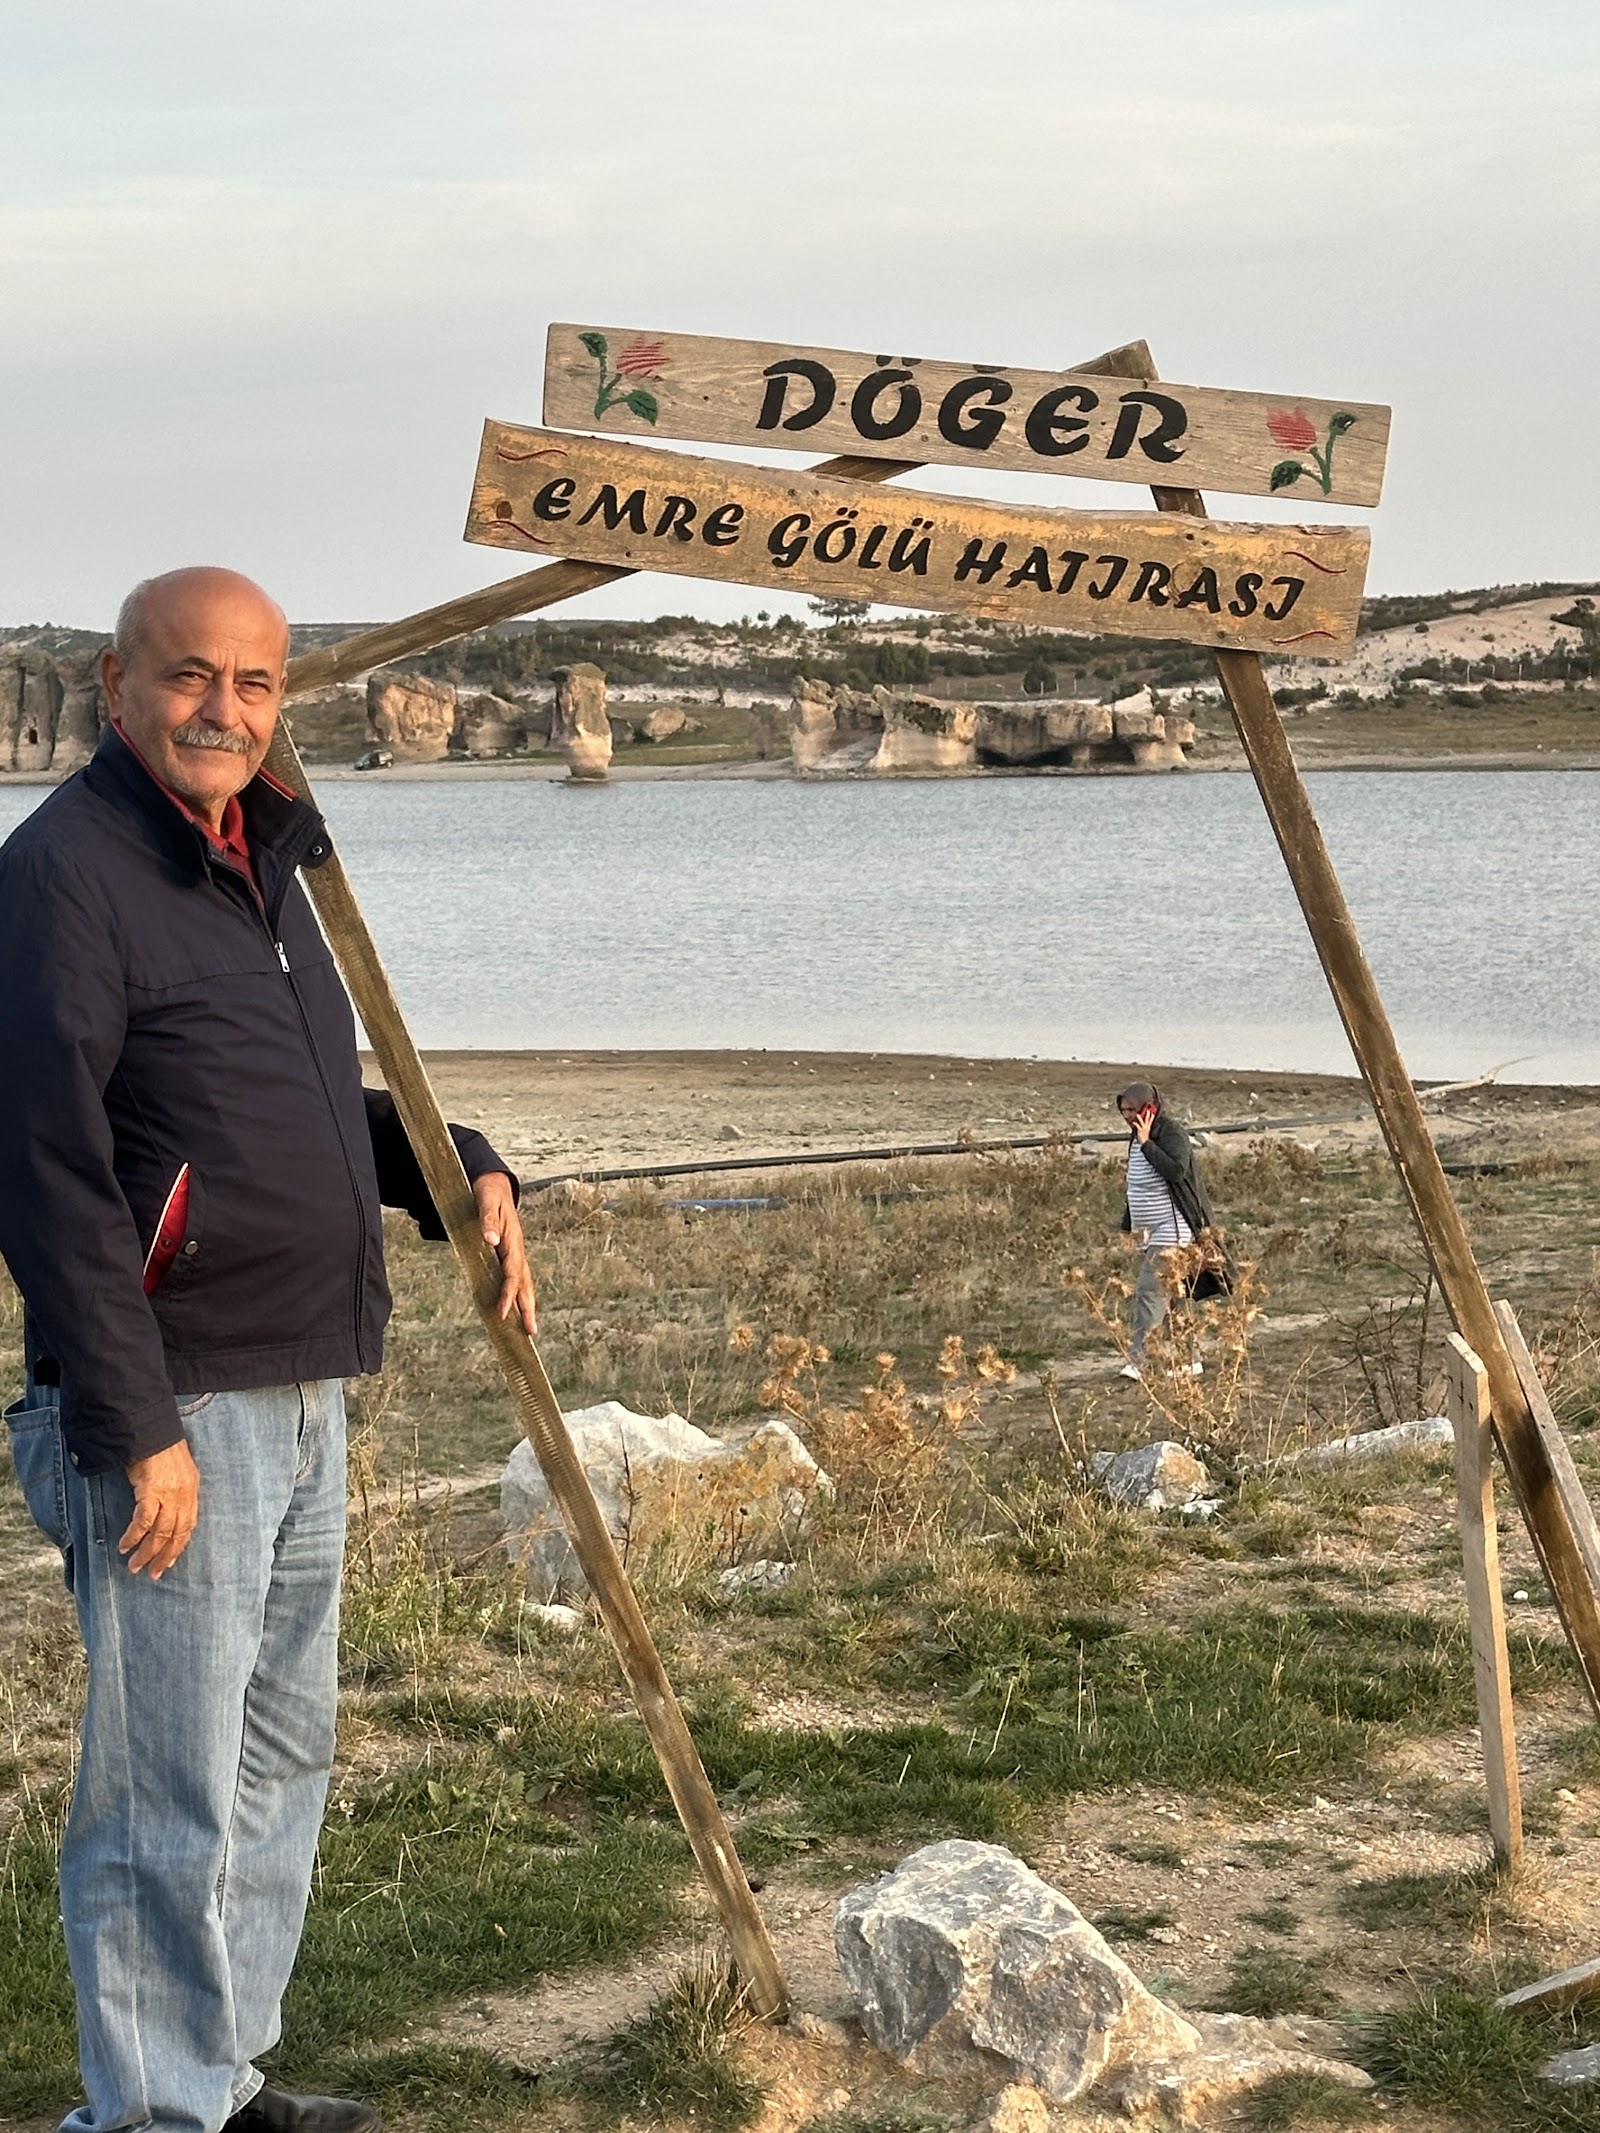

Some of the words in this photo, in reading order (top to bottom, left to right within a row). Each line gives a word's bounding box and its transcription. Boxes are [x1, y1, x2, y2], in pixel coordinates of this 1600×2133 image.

[533, 477, 744, 546] EMRE
[767, 506, 934, 576] GÖLÜ
[953, 538, 1305, 621] HATIRASI
